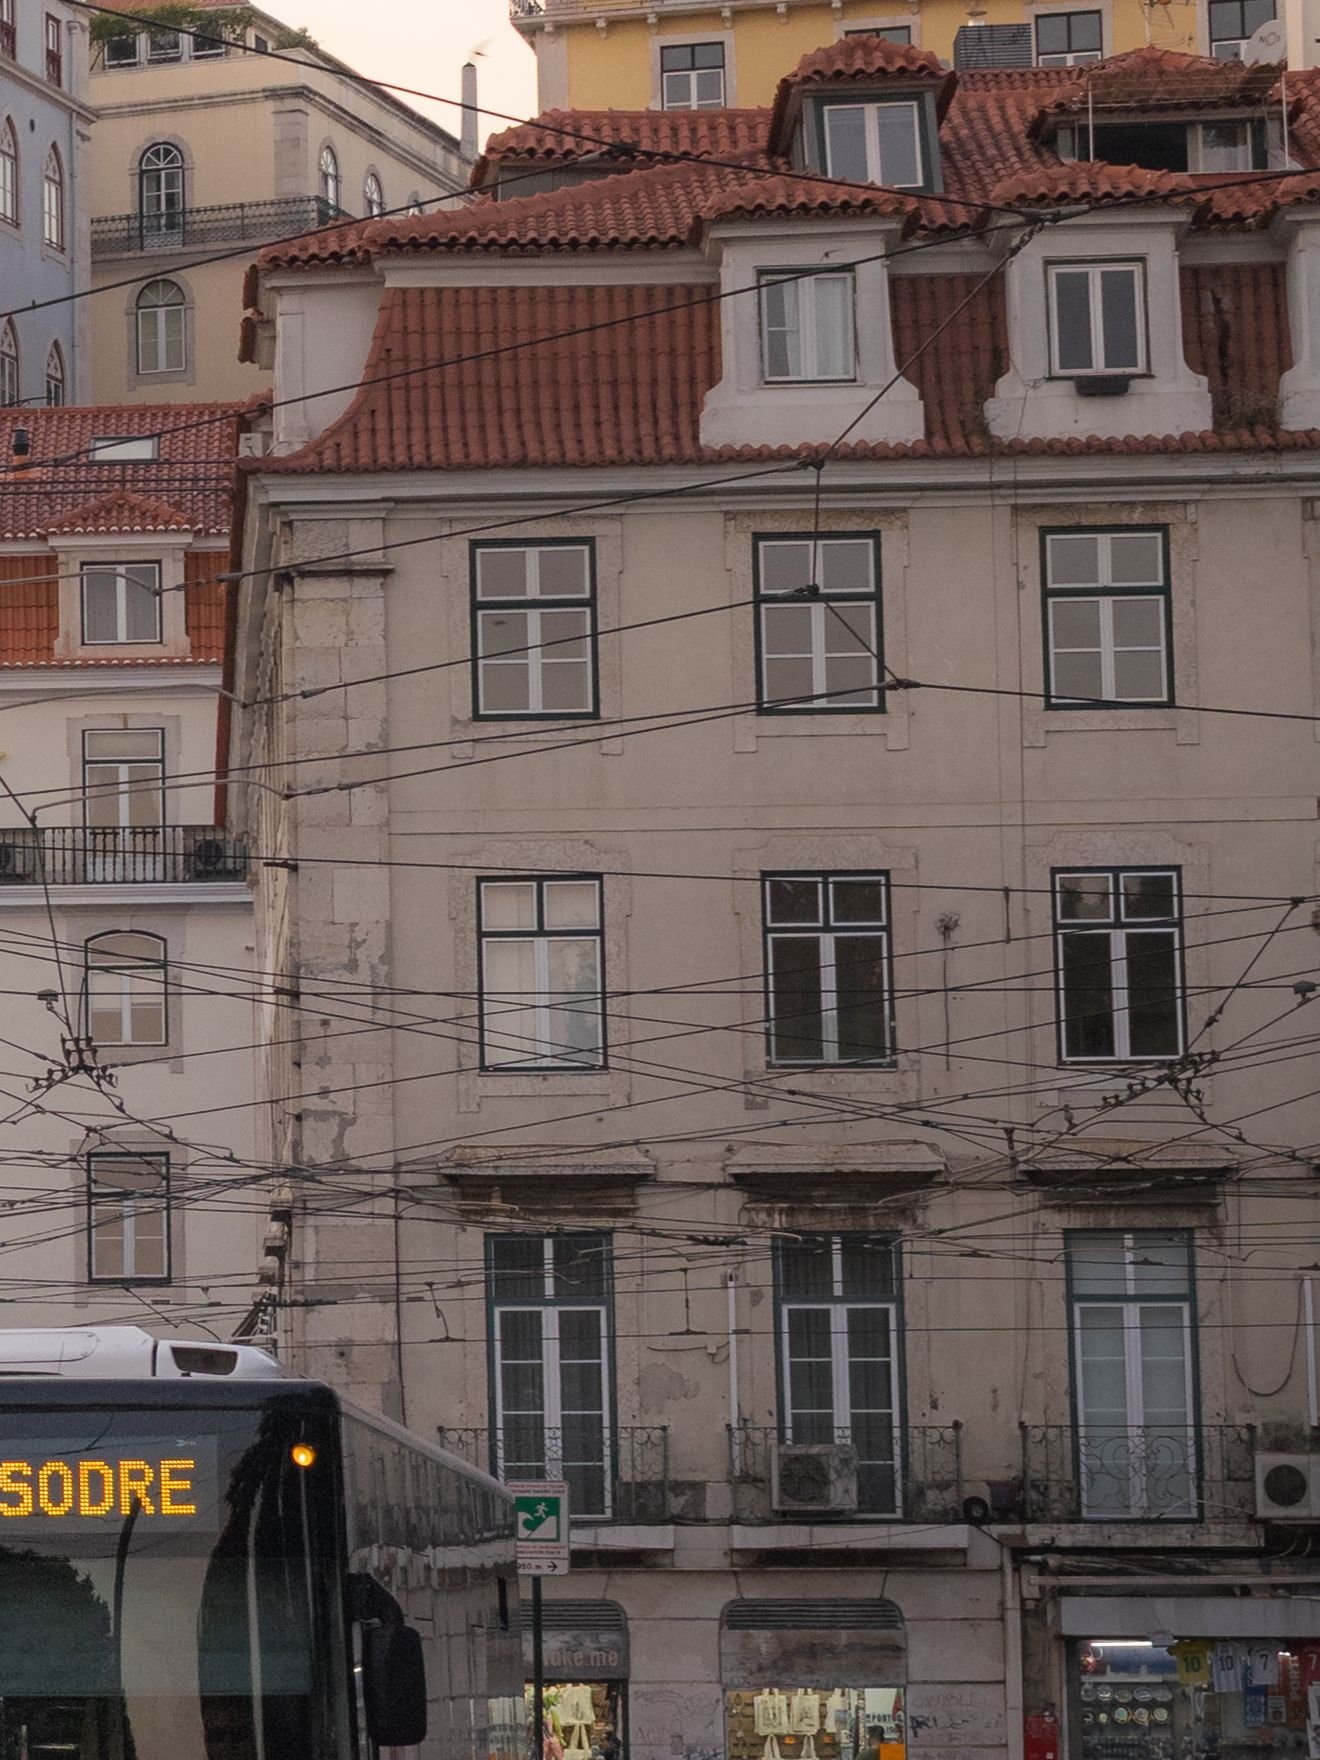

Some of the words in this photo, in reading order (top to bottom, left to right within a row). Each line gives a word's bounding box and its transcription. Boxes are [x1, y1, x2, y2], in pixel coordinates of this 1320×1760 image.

[1183, 1655, 1201, 1673] 10
[1218, 1655, 1234, 1672] 10
[1259, 1653, 1269, 1671] 7
